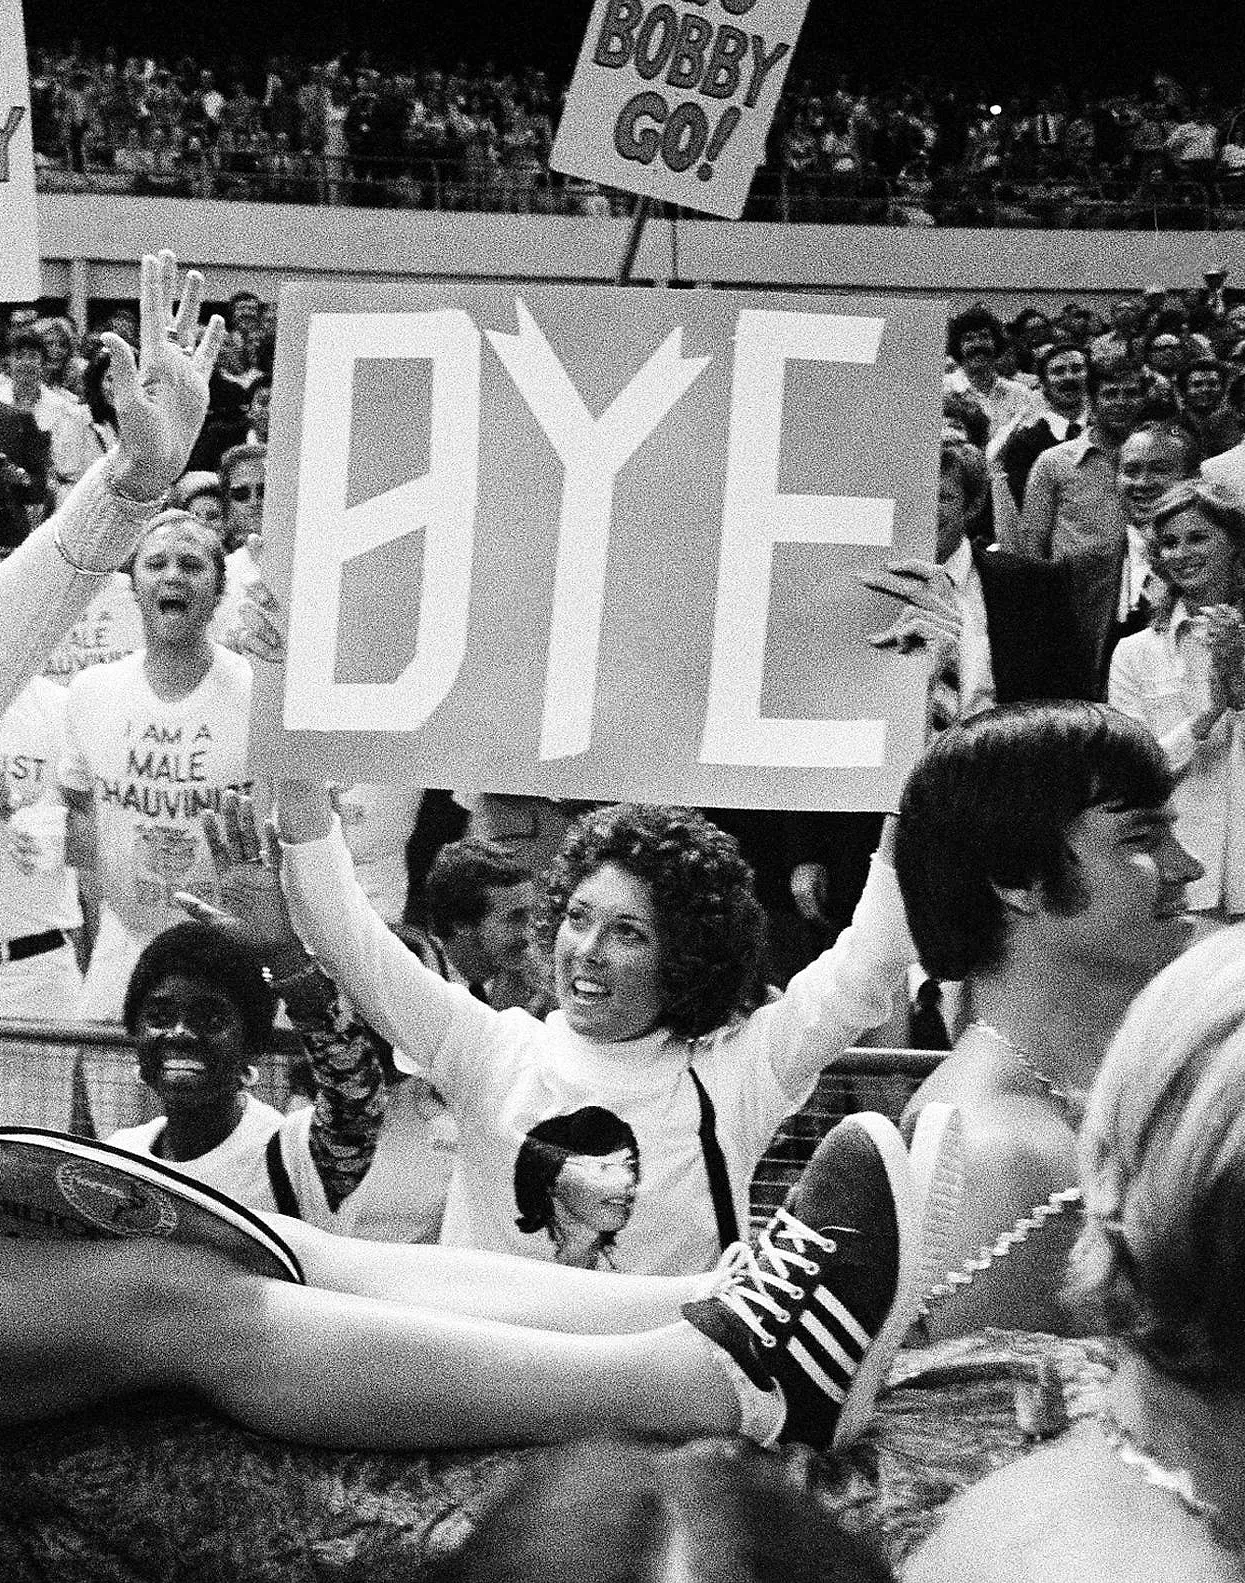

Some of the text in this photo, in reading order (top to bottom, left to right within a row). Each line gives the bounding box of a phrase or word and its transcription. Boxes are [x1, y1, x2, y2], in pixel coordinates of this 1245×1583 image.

[593, 0, 790, 108] BOBBY
[613, 91, 742, 182] GO!
[142, 723, 183, 744] AM
[193, 723, 213, 743] A
[126, 748, 208, 783] MALE
[96, 776, 254, 819] HAUVINI
